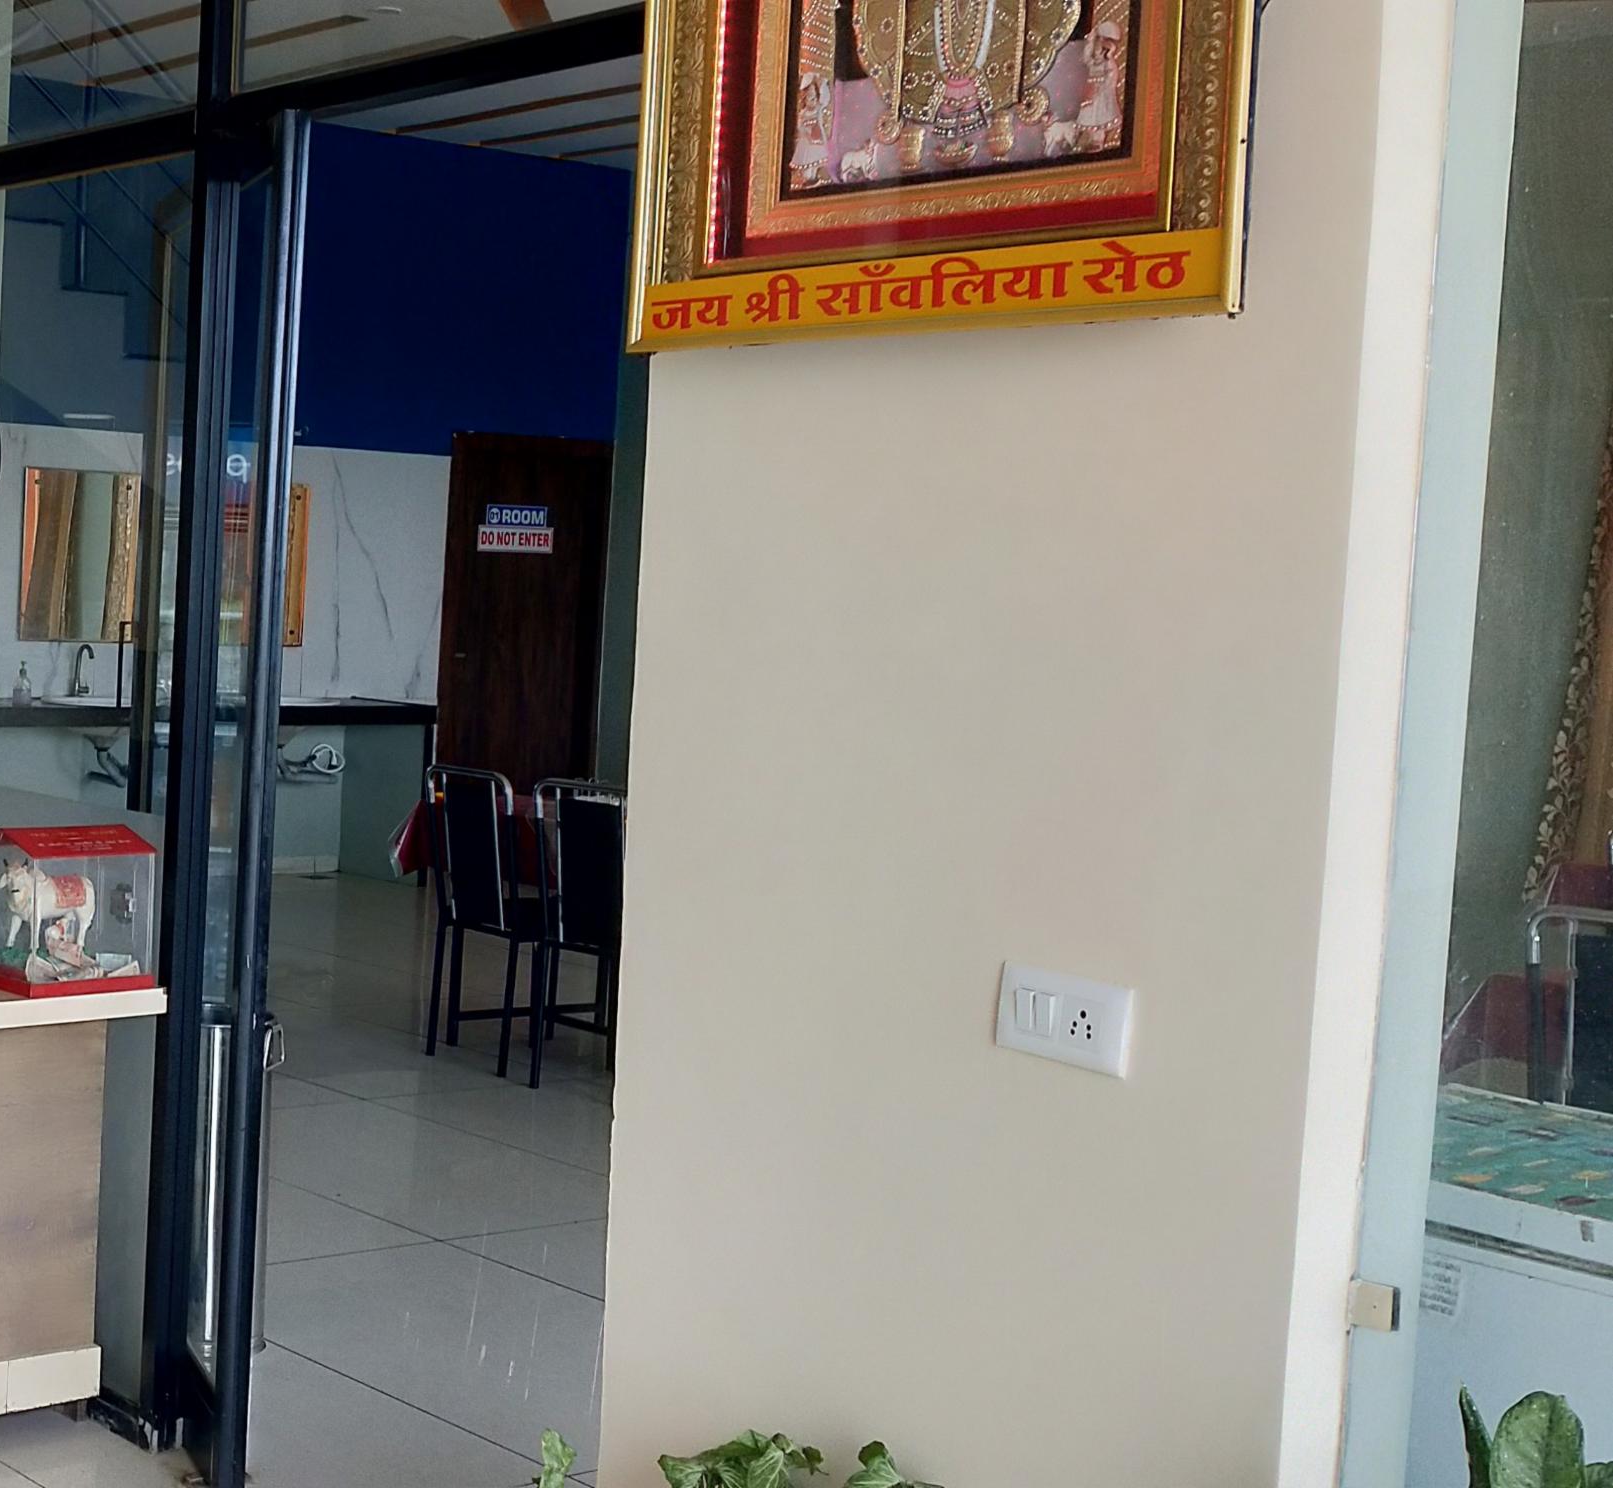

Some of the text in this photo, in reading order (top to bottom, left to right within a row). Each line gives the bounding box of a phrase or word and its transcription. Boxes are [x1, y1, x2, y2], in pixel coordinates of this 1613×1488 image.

[651, 240, 1191, 330] जय श्री साँवलिया सेठ
[502, 509, 544, 525] ROOM
[480, 531, 550, 547] DO NOT ENTER
